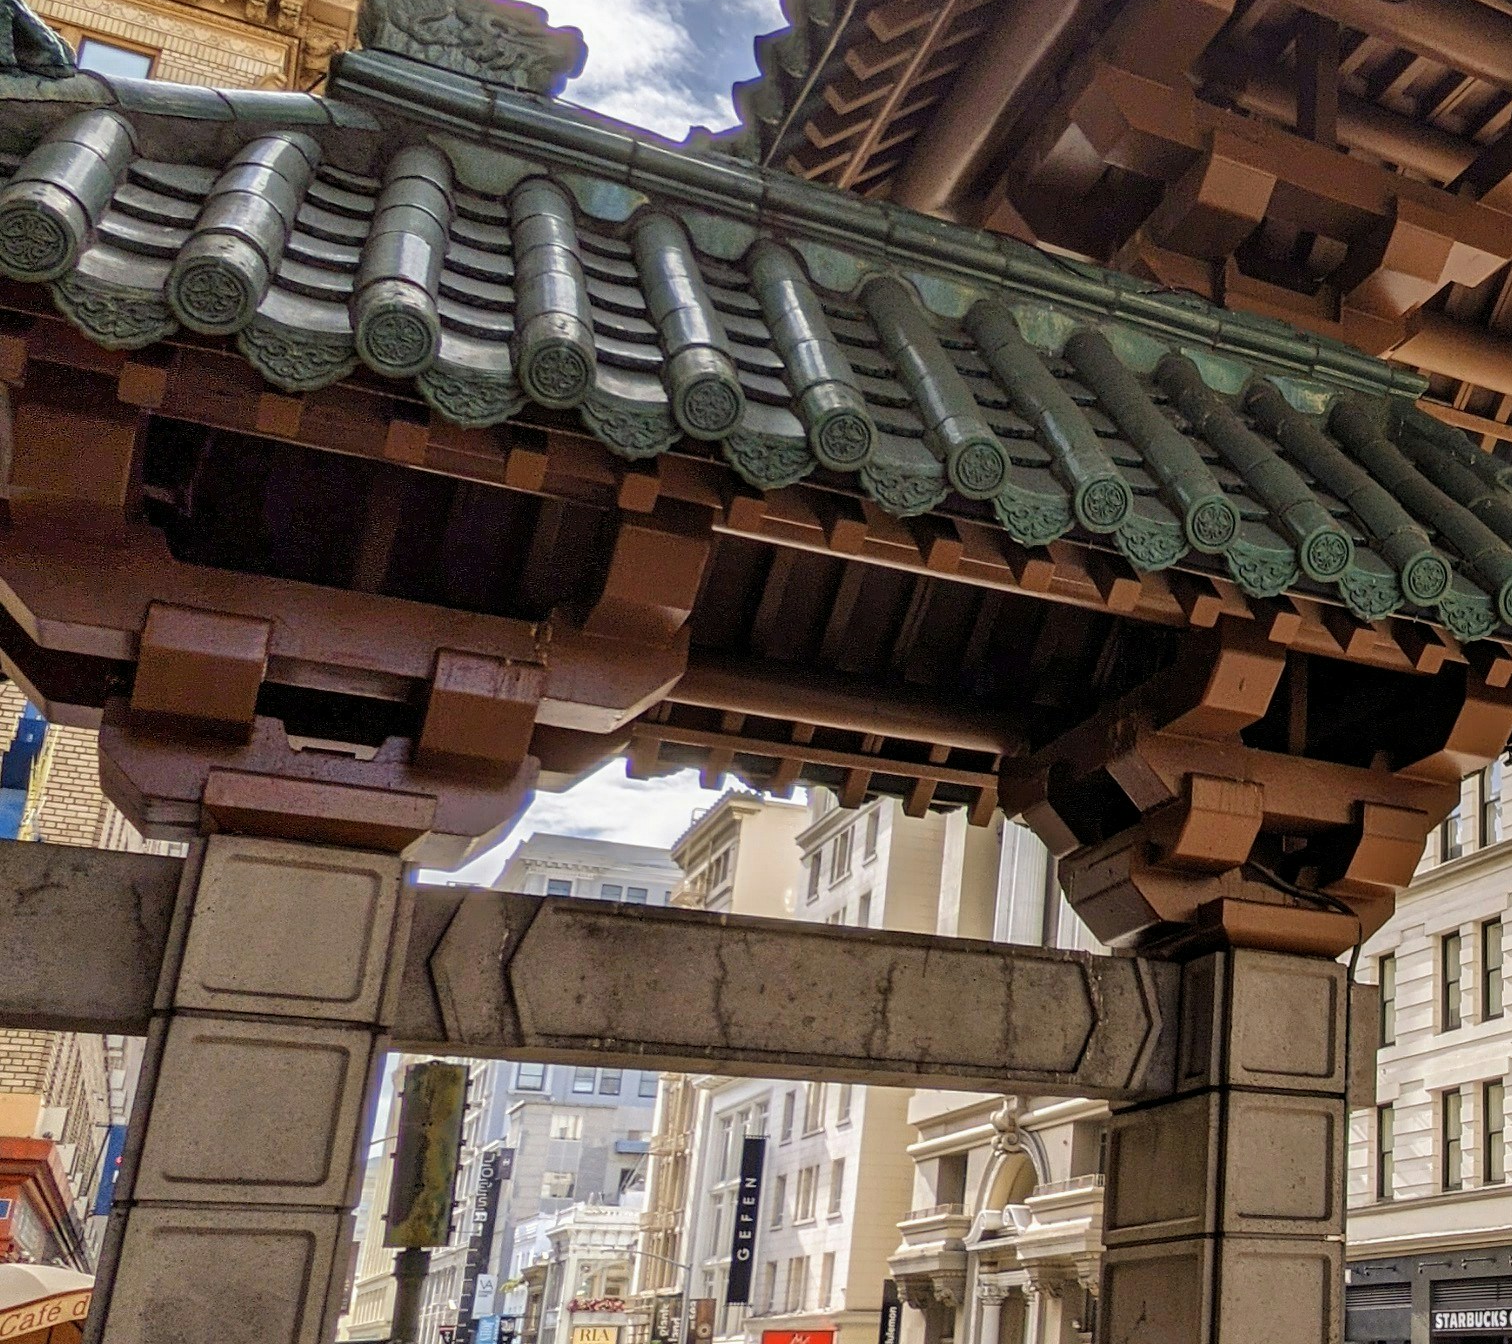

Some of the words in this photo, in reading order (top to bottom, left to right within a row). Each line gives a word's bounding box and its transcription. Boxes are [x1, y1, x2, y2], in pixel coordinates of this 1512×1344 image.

[736, 1177, 758, 1262] GEFEN
[0, 1300, 62, 1337] Café
[1435, 1310, 1508, 1329] STARBUCKS
